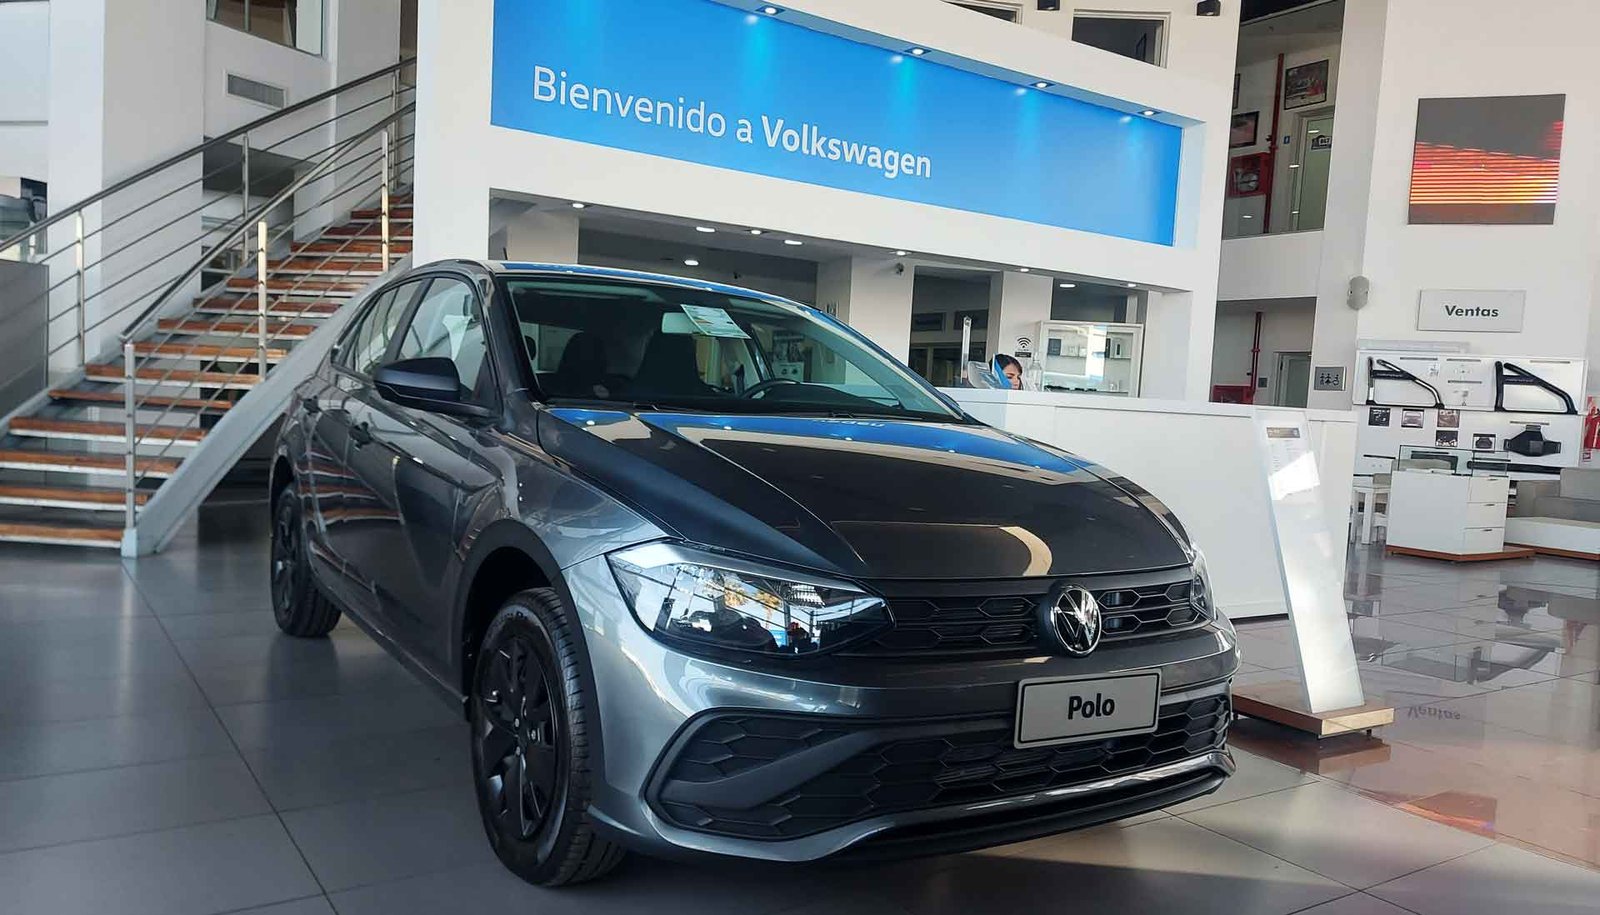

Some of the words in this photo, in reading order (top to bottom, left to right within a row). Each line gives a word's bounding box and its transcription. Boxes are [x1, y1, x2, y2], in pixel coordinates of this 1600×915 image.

[533, 65, 726, 137] Bienvenido
[735, 118, 753, 144] a
[761, 115, 931, 179] Volkswagen
[1444, 304, 1499, 317] Ventas
[1067, 692, 1116, 720] Polo
